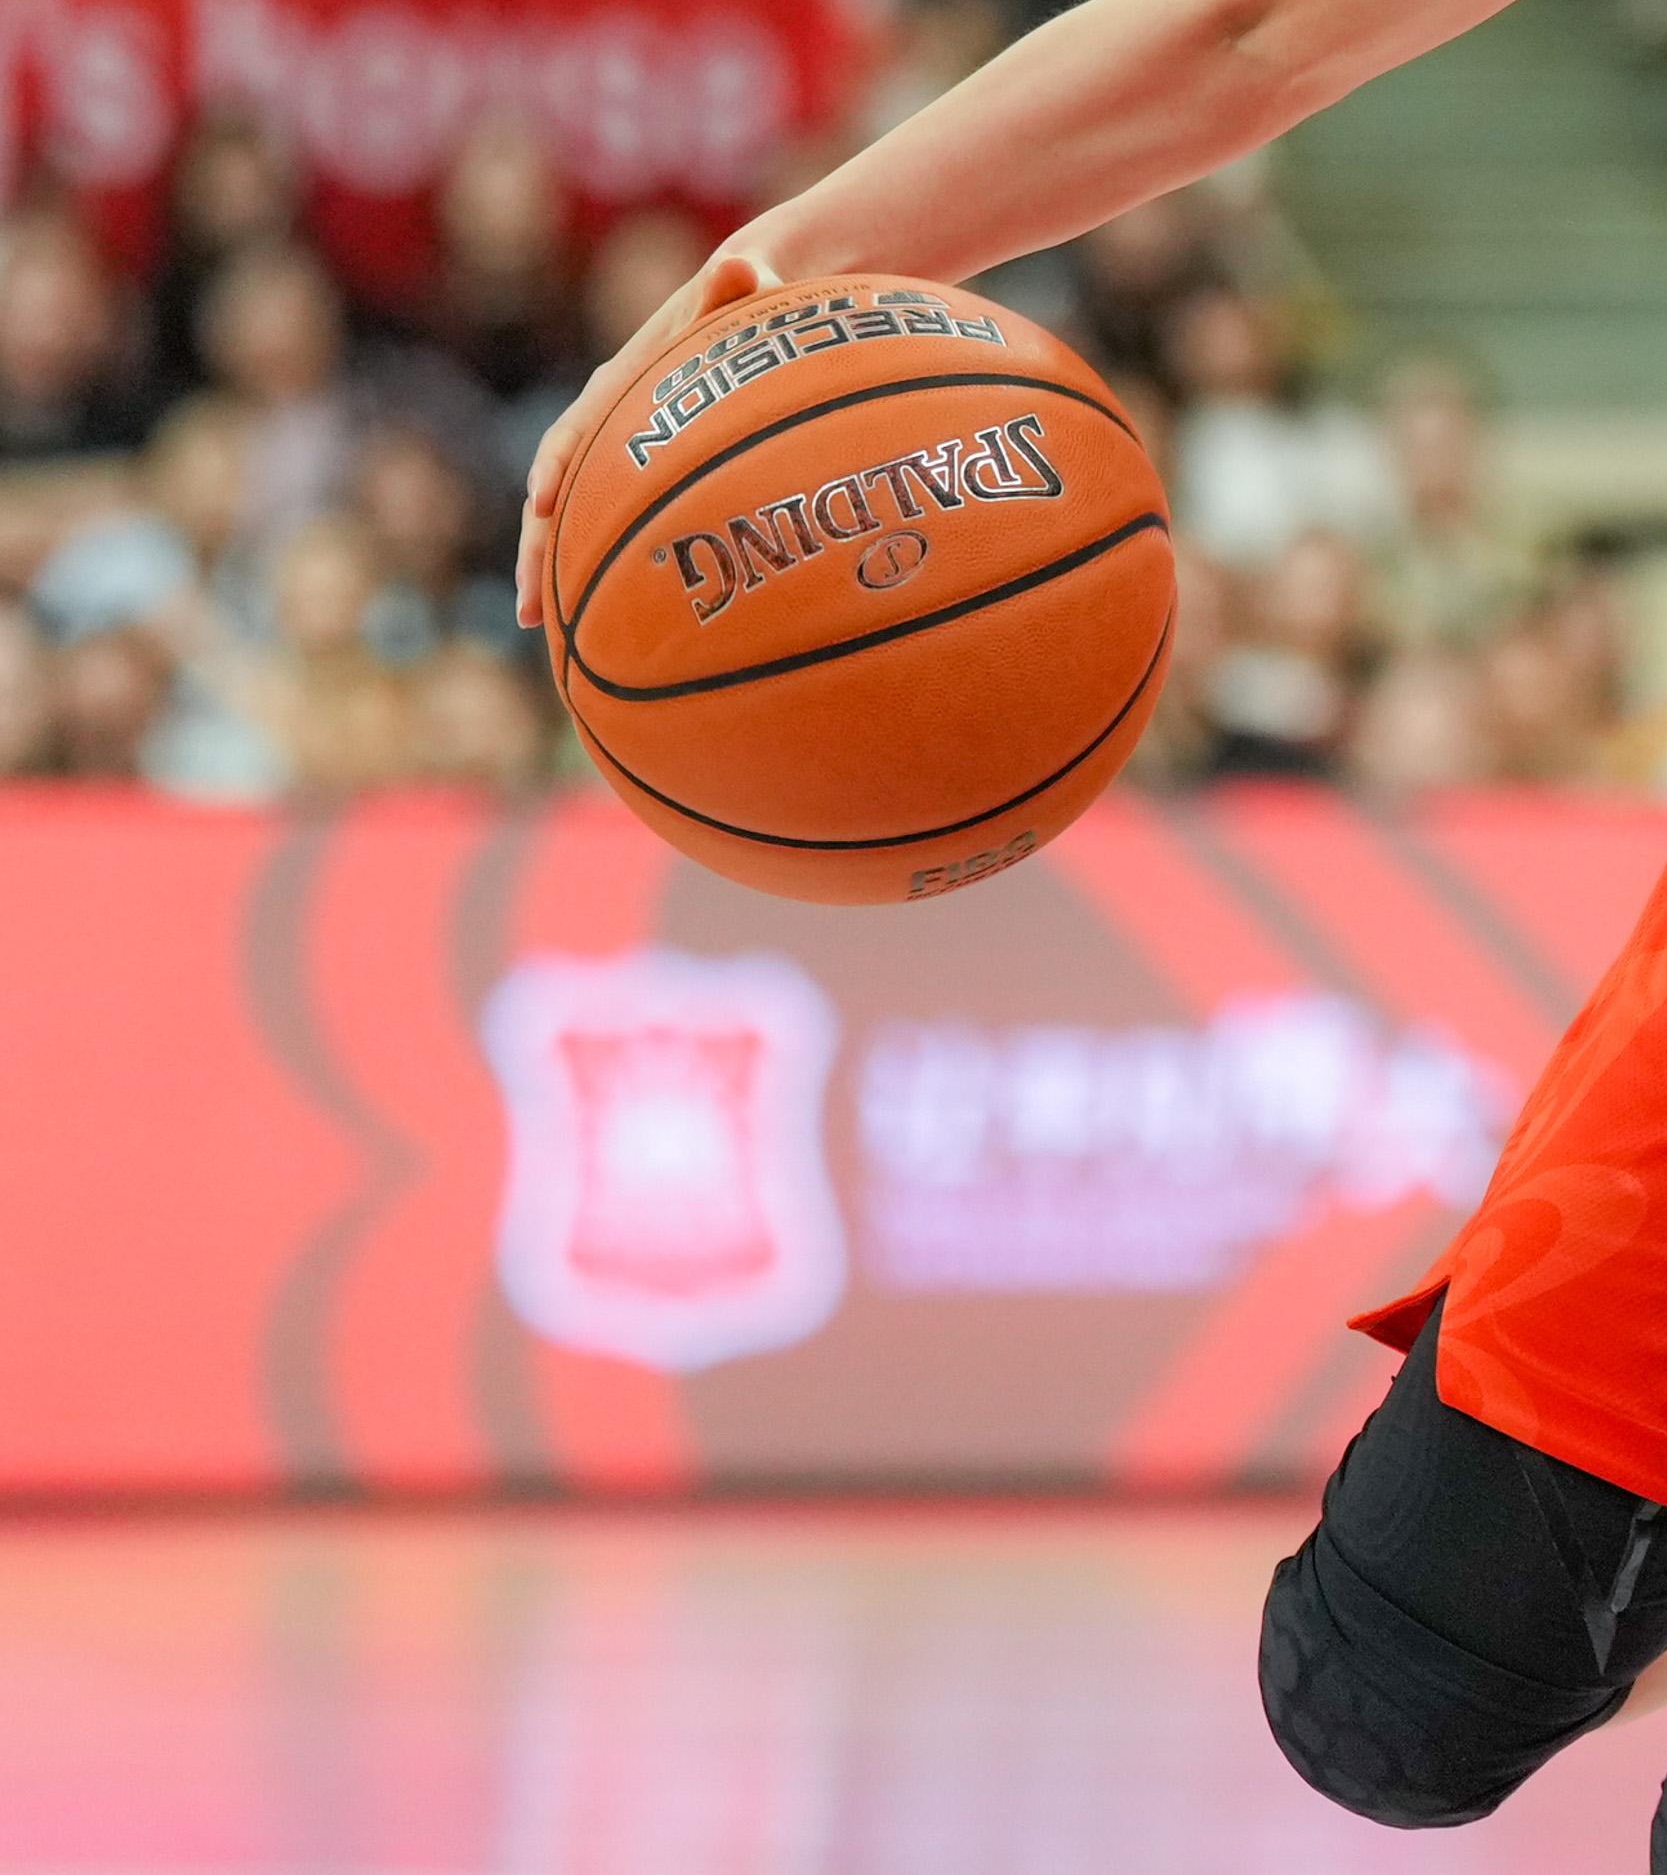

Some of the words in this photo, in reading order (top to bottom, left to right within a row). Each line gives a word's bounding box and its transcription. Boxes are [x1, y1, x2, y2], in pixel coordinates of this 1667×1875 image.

[625, 309, 1008, 470] PRECISION
[671, 413, 1065, 625] SPALDING
[909, 829, 1037, 894] FIBA
